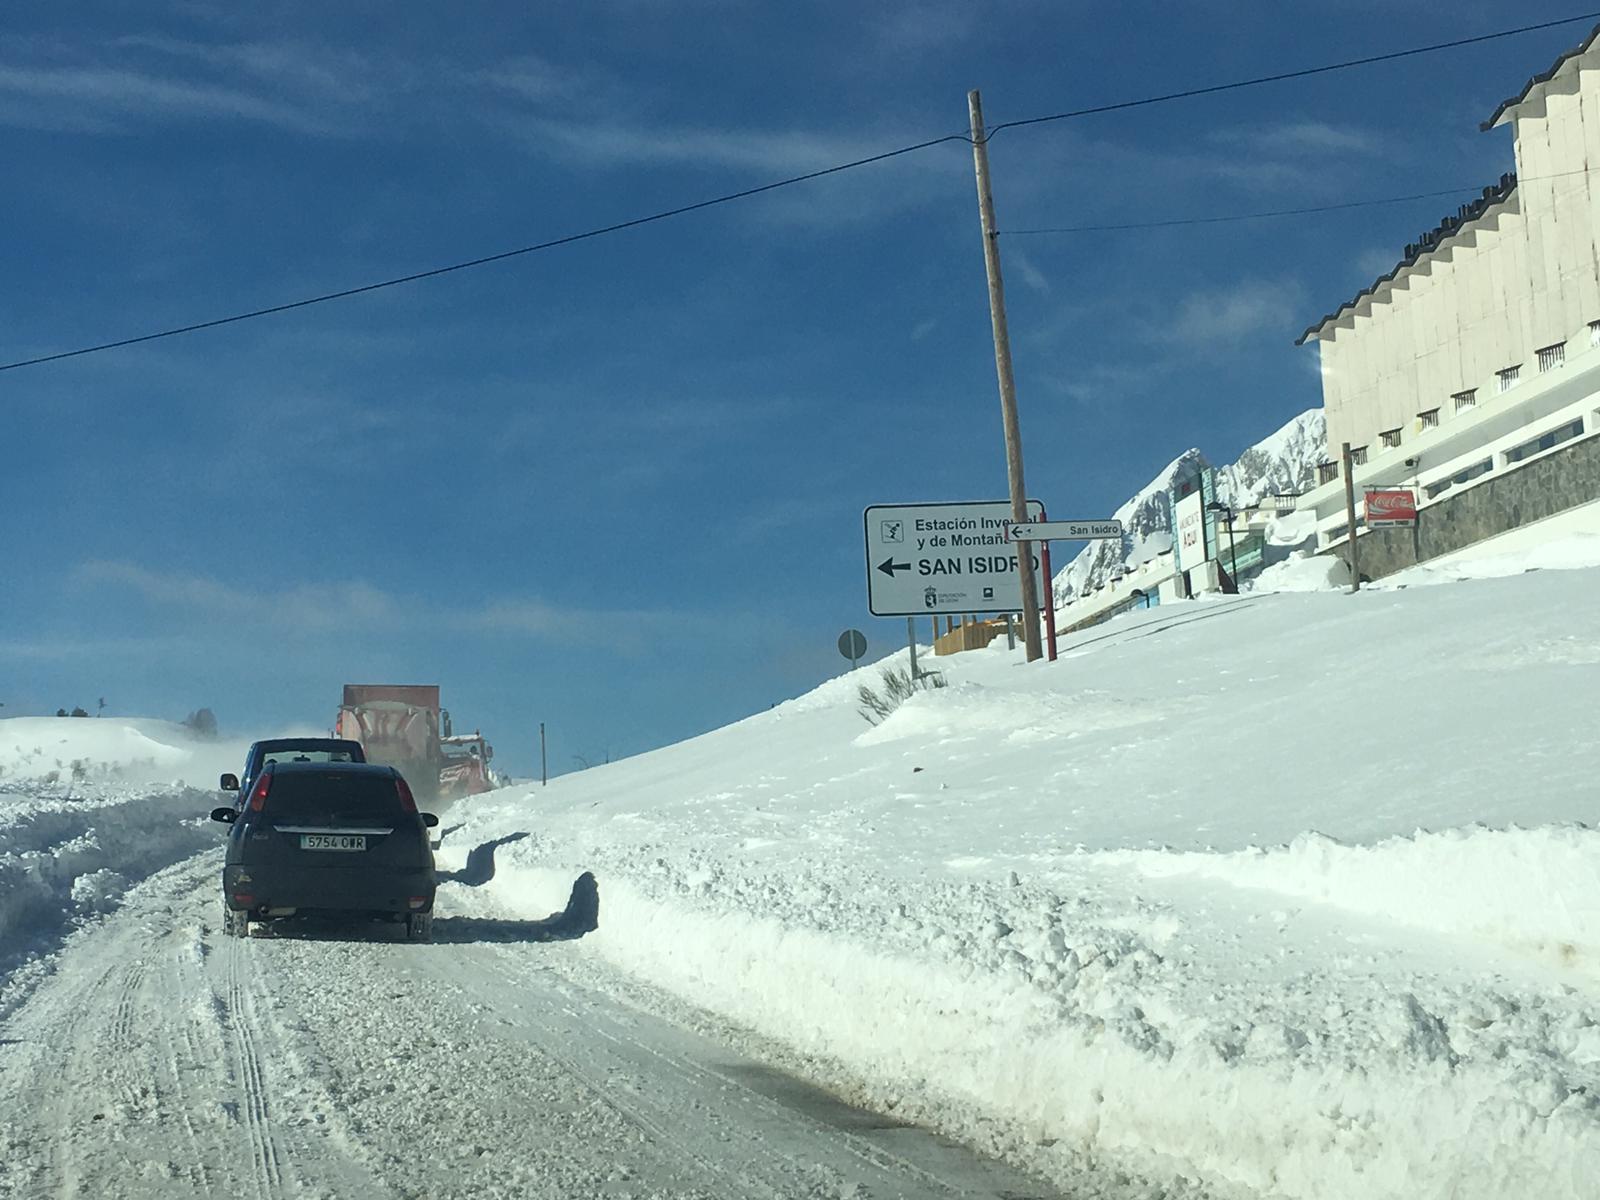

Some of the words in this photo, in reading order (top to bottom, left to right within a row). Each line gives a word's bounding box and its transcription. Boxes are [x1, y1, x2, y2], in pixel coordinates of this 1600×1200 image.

[915, 517, 977, 531] Estación
[981, 515, 1036, 528] Invel
[1070, 526, 1088, 535] San
[1091, 525, 1119, 535] Isidro
[916, 538, 925, 550] y
[930, 535, 947, 547] de
[951, 532, 1010, 546] Montañ
[918, 558, 961, 576] SAN
[308, 836, 337, 848] 5754
